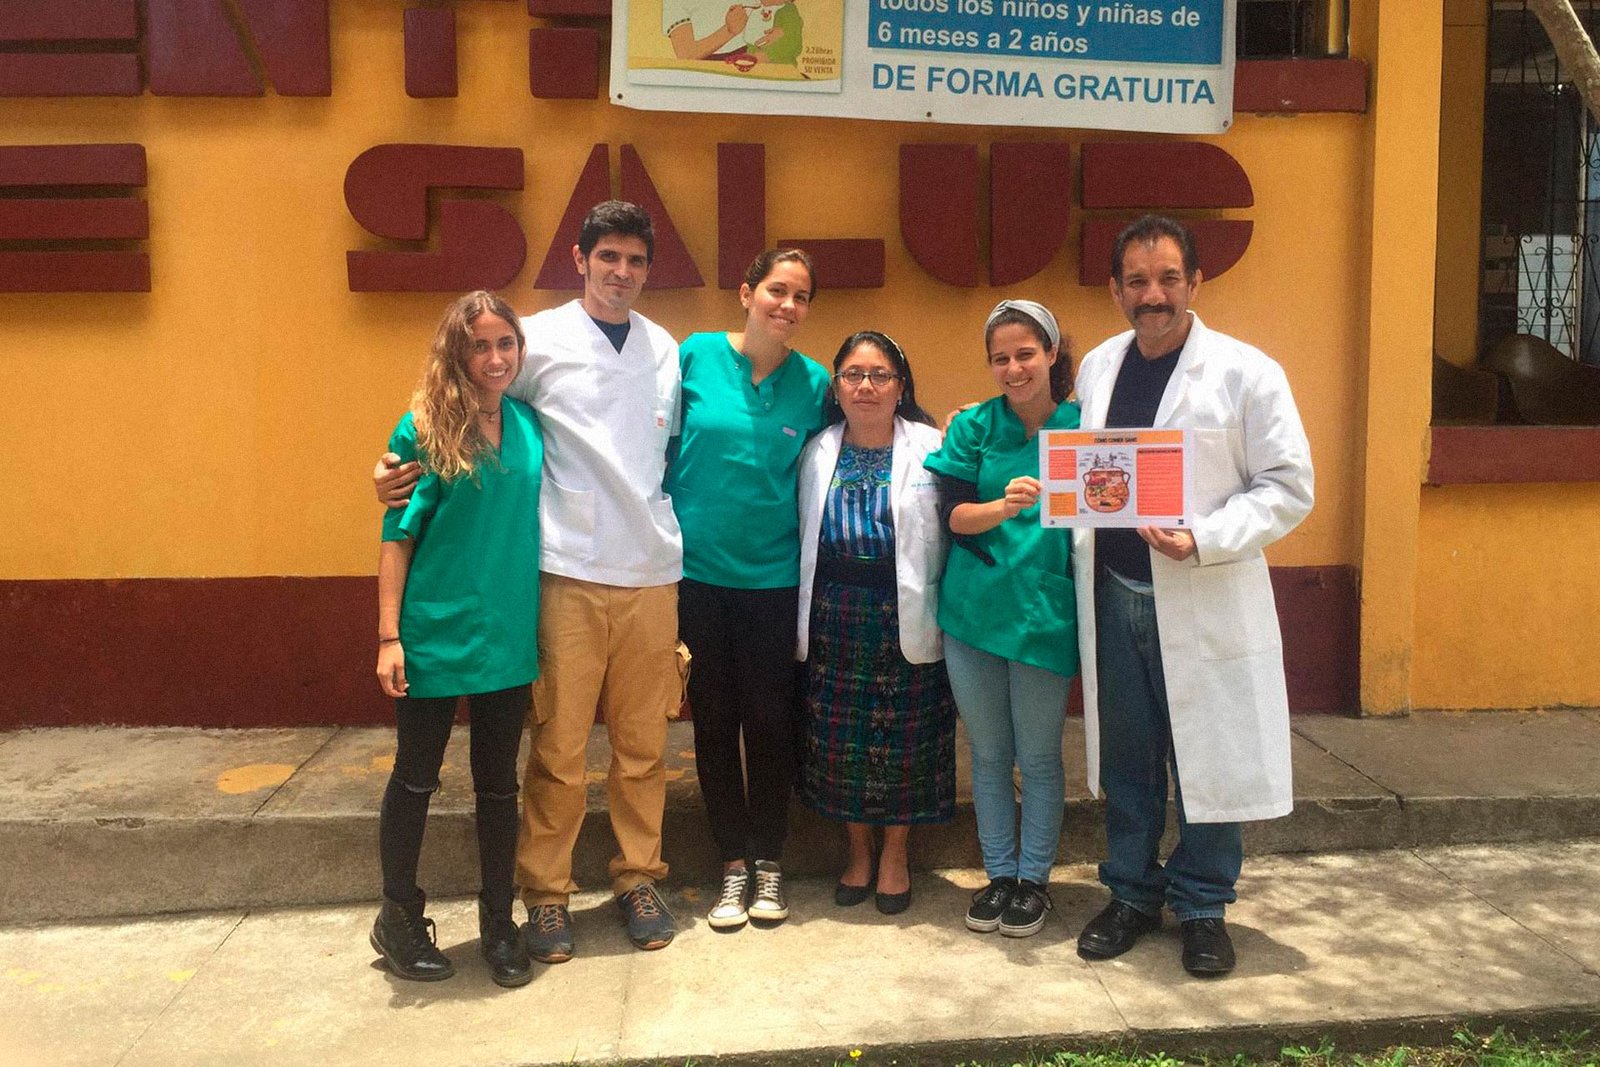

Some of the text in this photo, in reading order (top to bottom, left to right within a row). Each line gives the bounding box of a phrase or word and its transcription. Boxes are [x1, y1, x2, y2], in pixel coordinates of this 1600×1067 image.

[879, 0, 1201, 27] todos los niños y niñas de
[877, 21, 1089, 54] 6 meses a 2 años
[872, 63, 1216, 105] DE FORMA GRATUITA
[343, 142, 1255, 292] SALUD
